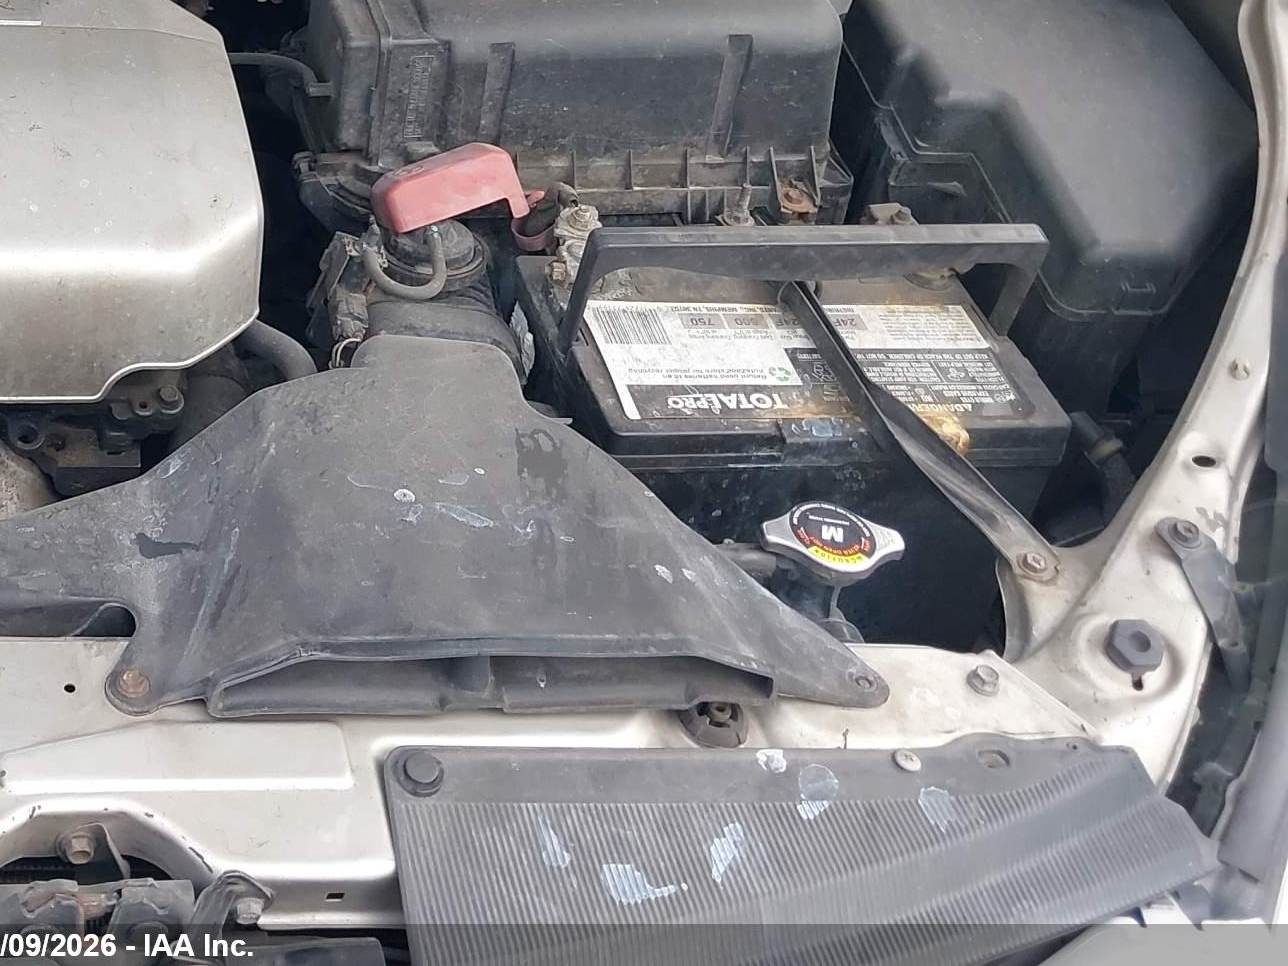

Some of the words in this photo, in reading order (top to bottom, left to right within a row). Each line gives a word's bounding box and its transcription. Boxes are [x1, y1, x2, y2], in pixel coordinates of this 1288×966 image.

[690, 318, 715, 326] 750
[832, 317, 858, 327] 24F
[821, 525, 844, 542] M
[813, 549, 857, 564] CAUTION
